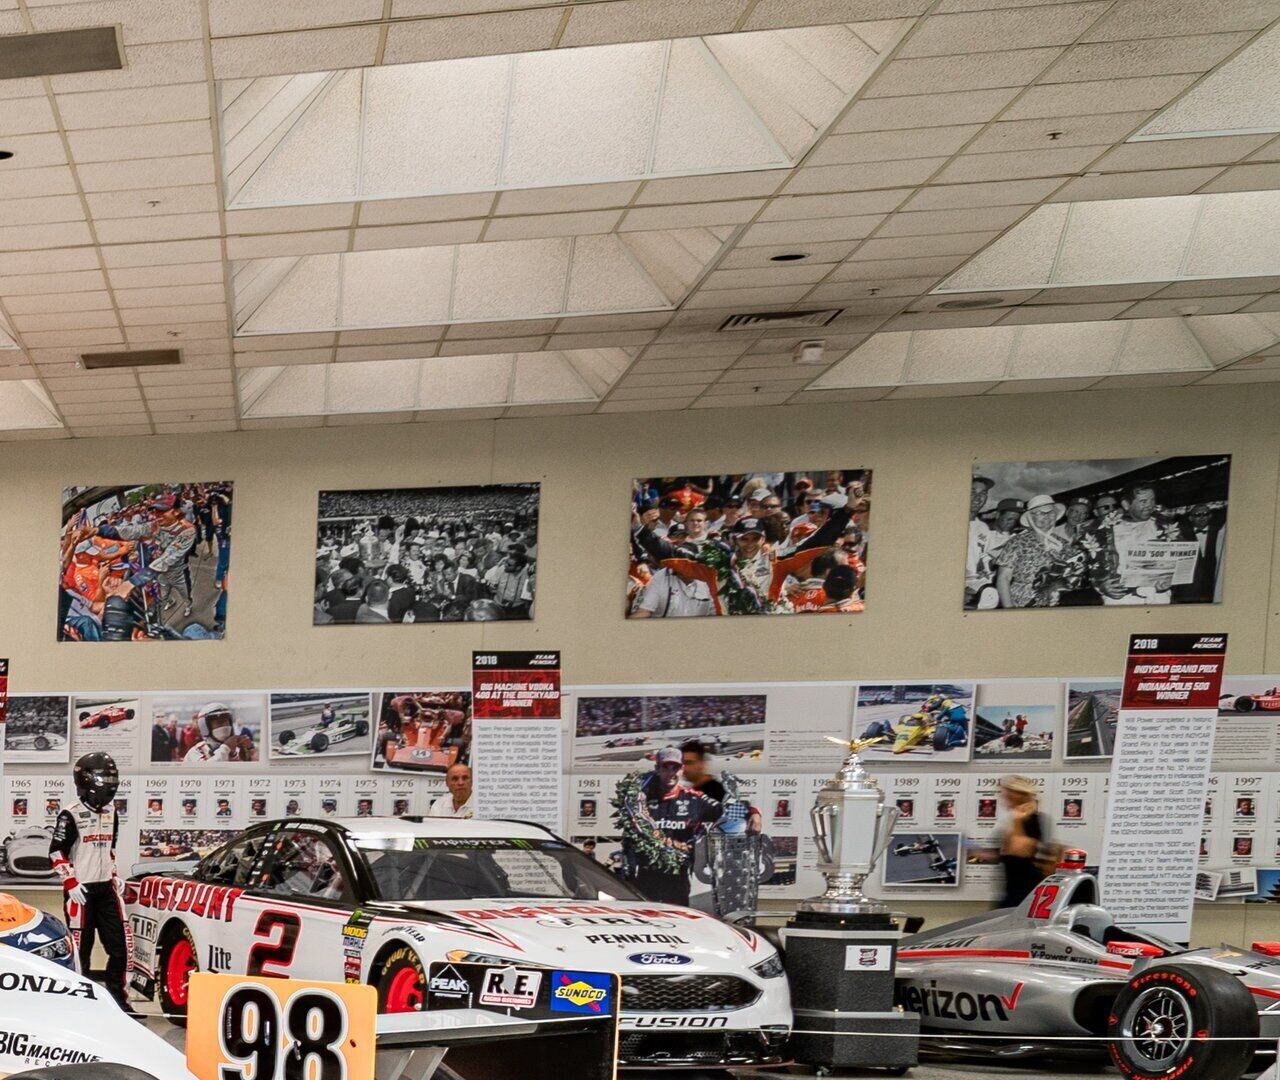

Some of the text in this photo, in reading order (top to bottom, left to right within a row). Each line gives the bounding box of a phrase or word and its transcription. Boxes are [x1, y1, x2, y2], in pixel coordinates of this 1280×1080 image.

[1134, 639, 1158, 649] 2018
[475, 656, 498, 665] 2018
[1134, 664, 1218, 674] INDYCAR GRAND PRIX
[1137, 682, 1210, 691] INDIANAPOLIS 500
[1156, 692, 1190, 700] WINNER
[895, 778, 919, 786] 1989
[140, 877, 243, 922] DISCOUNT
[1026, 885, 1059, 919] 12
[344, 926, 368, 938] MOOG
[246, 908, 302, 979] 2
[585, 934, 690, 946] PENNZOIL
[1031, 951, 1068, 961] V-Power
[1107, 945, 1144, 956] Mazak
[208, 944, 232, 973] Lite
[640, 954, 682, 964] Ford
[430, 978, 468, 992] PEAK
[1132, 972, 1197, 996] Firestone
[556, 986, 605, 1000] SUNOCO
